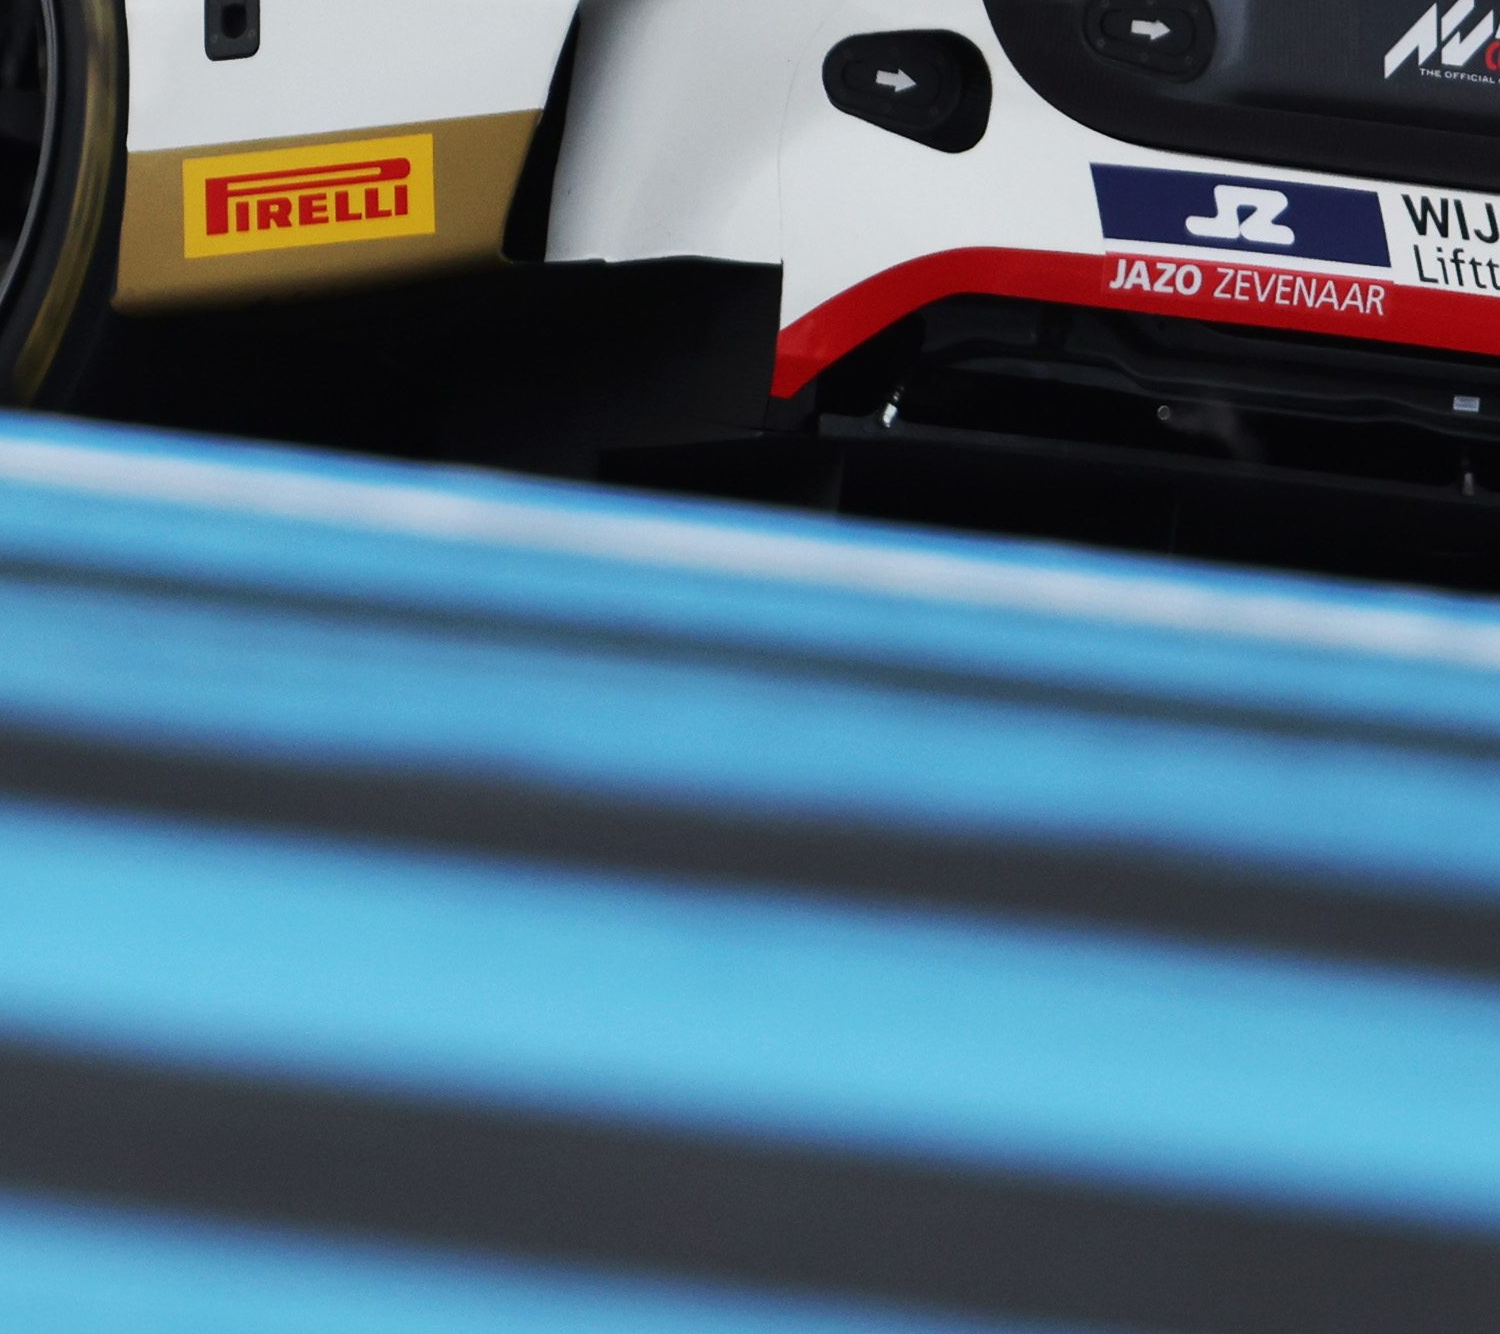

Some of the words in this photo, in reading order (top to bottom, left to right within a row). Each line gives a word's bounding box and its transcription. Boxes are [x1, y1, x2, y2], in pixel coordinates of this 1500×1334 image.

[1419, 68, 1442, 78] THE
[1445, 70, 1496, 84] OFFICIAL
[205, 157, 411, 236] PIRELLI
[1109, 258, 1203, 297] JAZO
[1213, 265, 1386, 316] ZEVENAAR
